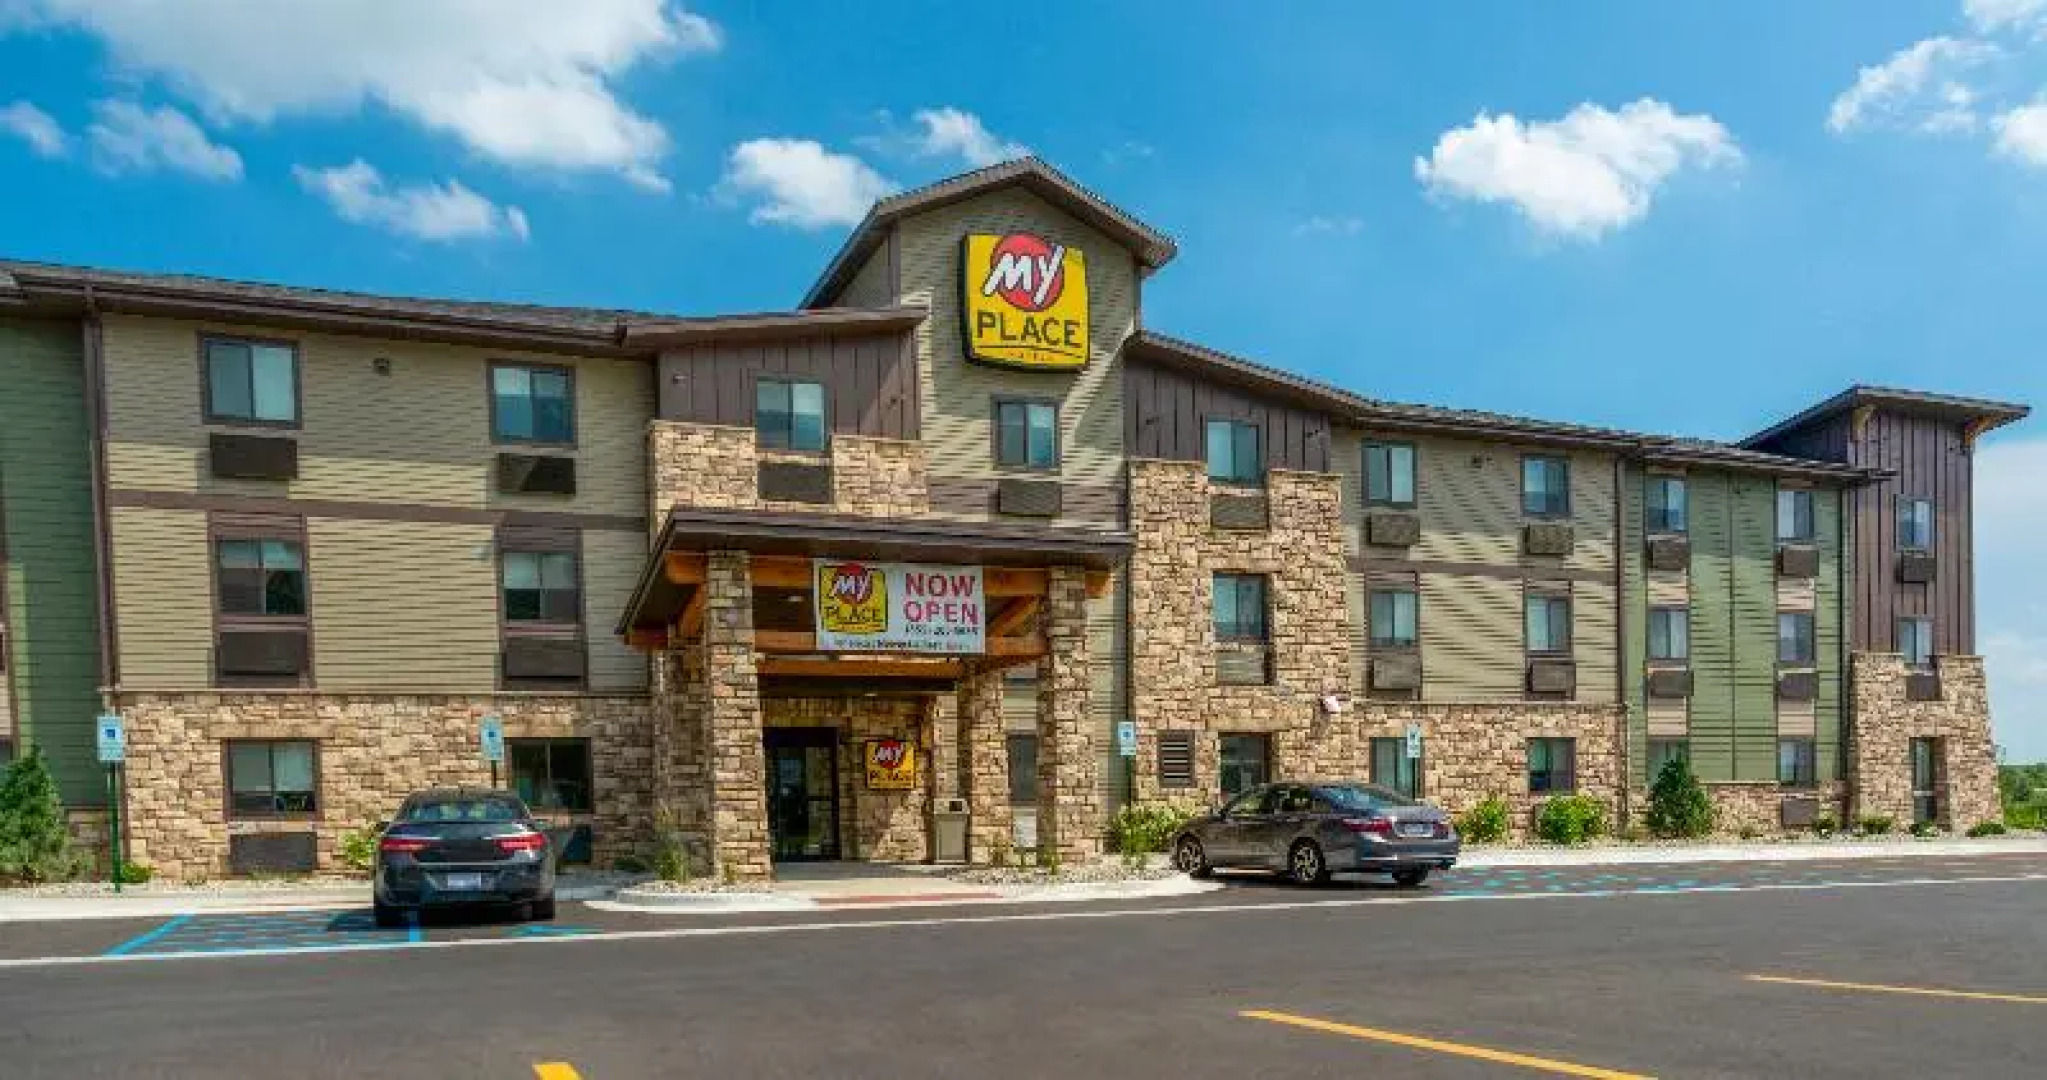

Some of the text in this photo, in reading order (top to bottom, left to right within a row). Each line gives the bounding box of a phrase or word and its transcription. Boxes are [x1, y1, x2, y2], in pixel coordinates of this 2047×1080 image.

[977, 311, 1083, 348] PLACE
[905, 573, 976, 597] NOW
[824, 606, 884, 622] PLACE
[904, 601, 979, 625] OPEN
